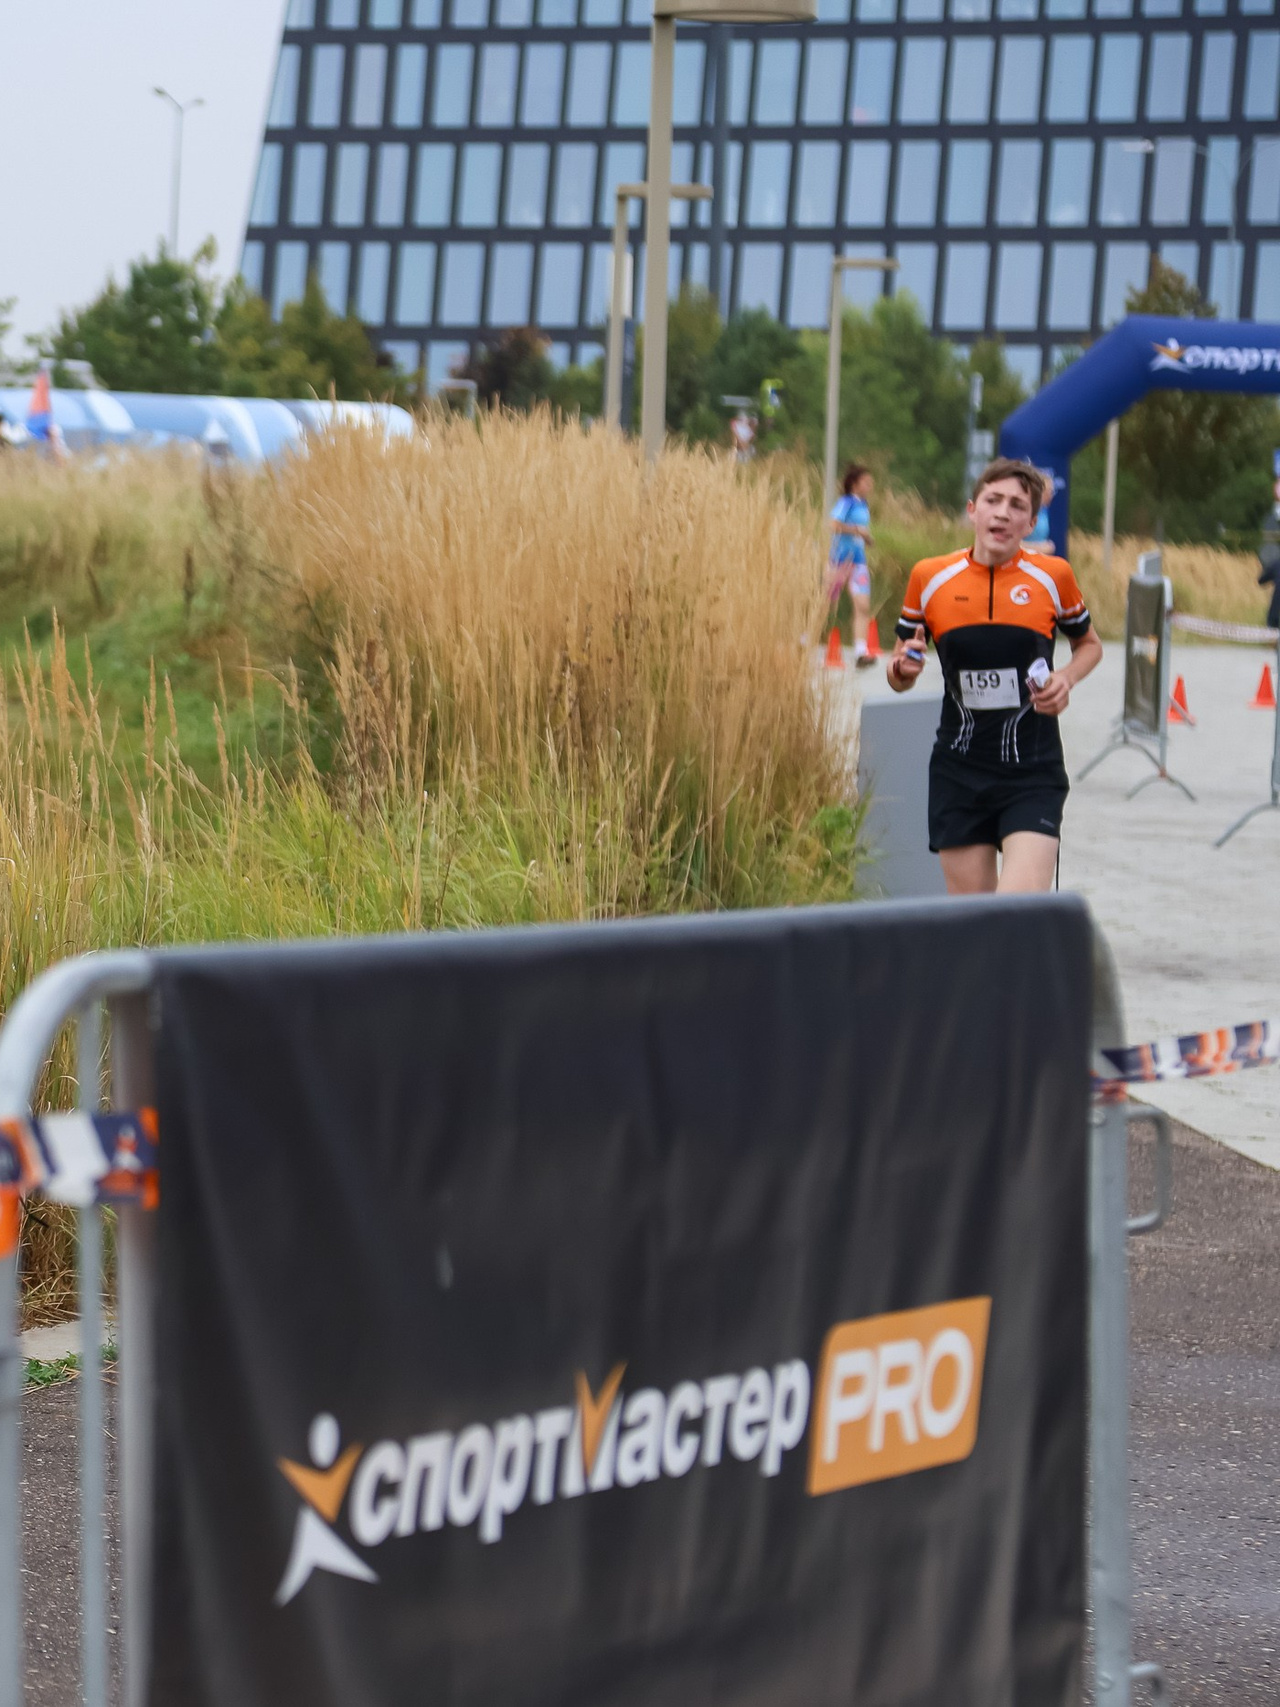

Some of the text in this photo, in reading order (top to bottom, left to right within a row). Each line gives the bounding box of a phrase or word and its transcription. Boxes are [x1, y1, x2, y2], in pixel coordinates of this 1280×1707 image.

[1184, 345, 1280, 374] спорт
[965, 671, 1001, 689] 159
[822, 1327, 974, 1464] PRO
